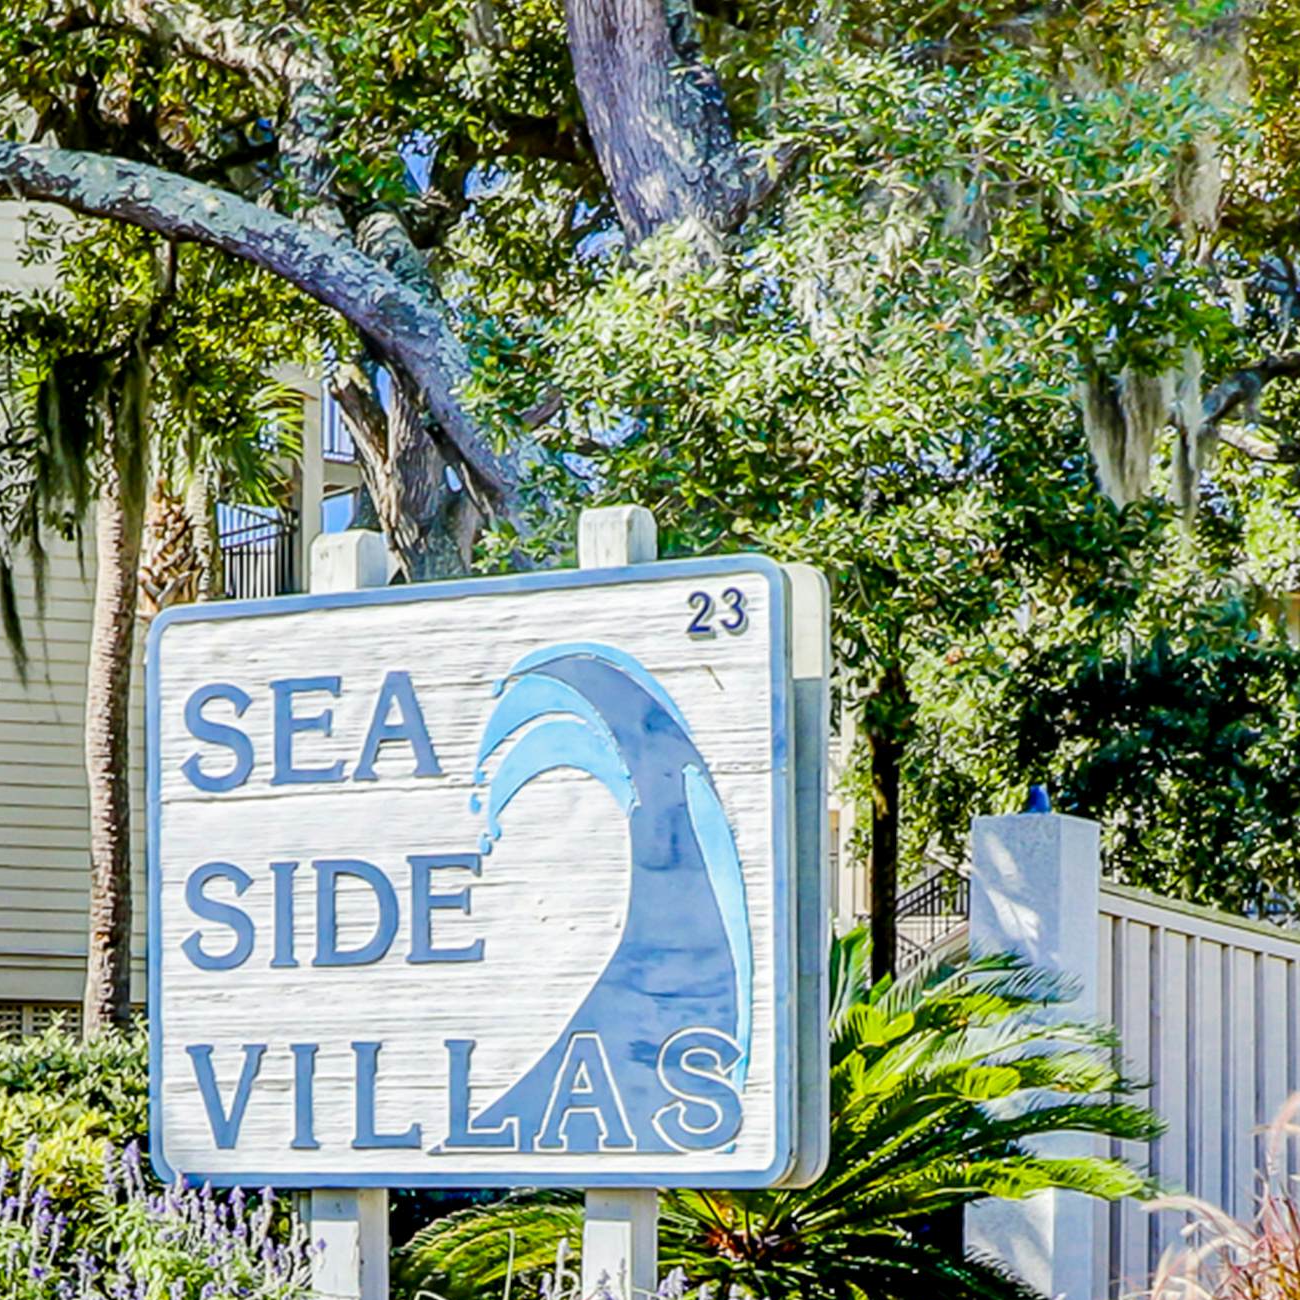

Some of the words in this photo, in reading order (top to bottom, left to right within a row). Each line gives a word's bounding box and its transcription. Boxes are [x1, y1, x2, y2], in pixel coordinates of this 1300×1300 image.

[685, 586, 749, 638] 23
[180, 669, 444, 793] SEA
[180, 851, 486, 972] SIDE
[185, 1026, 748, 1155] VILLAS
